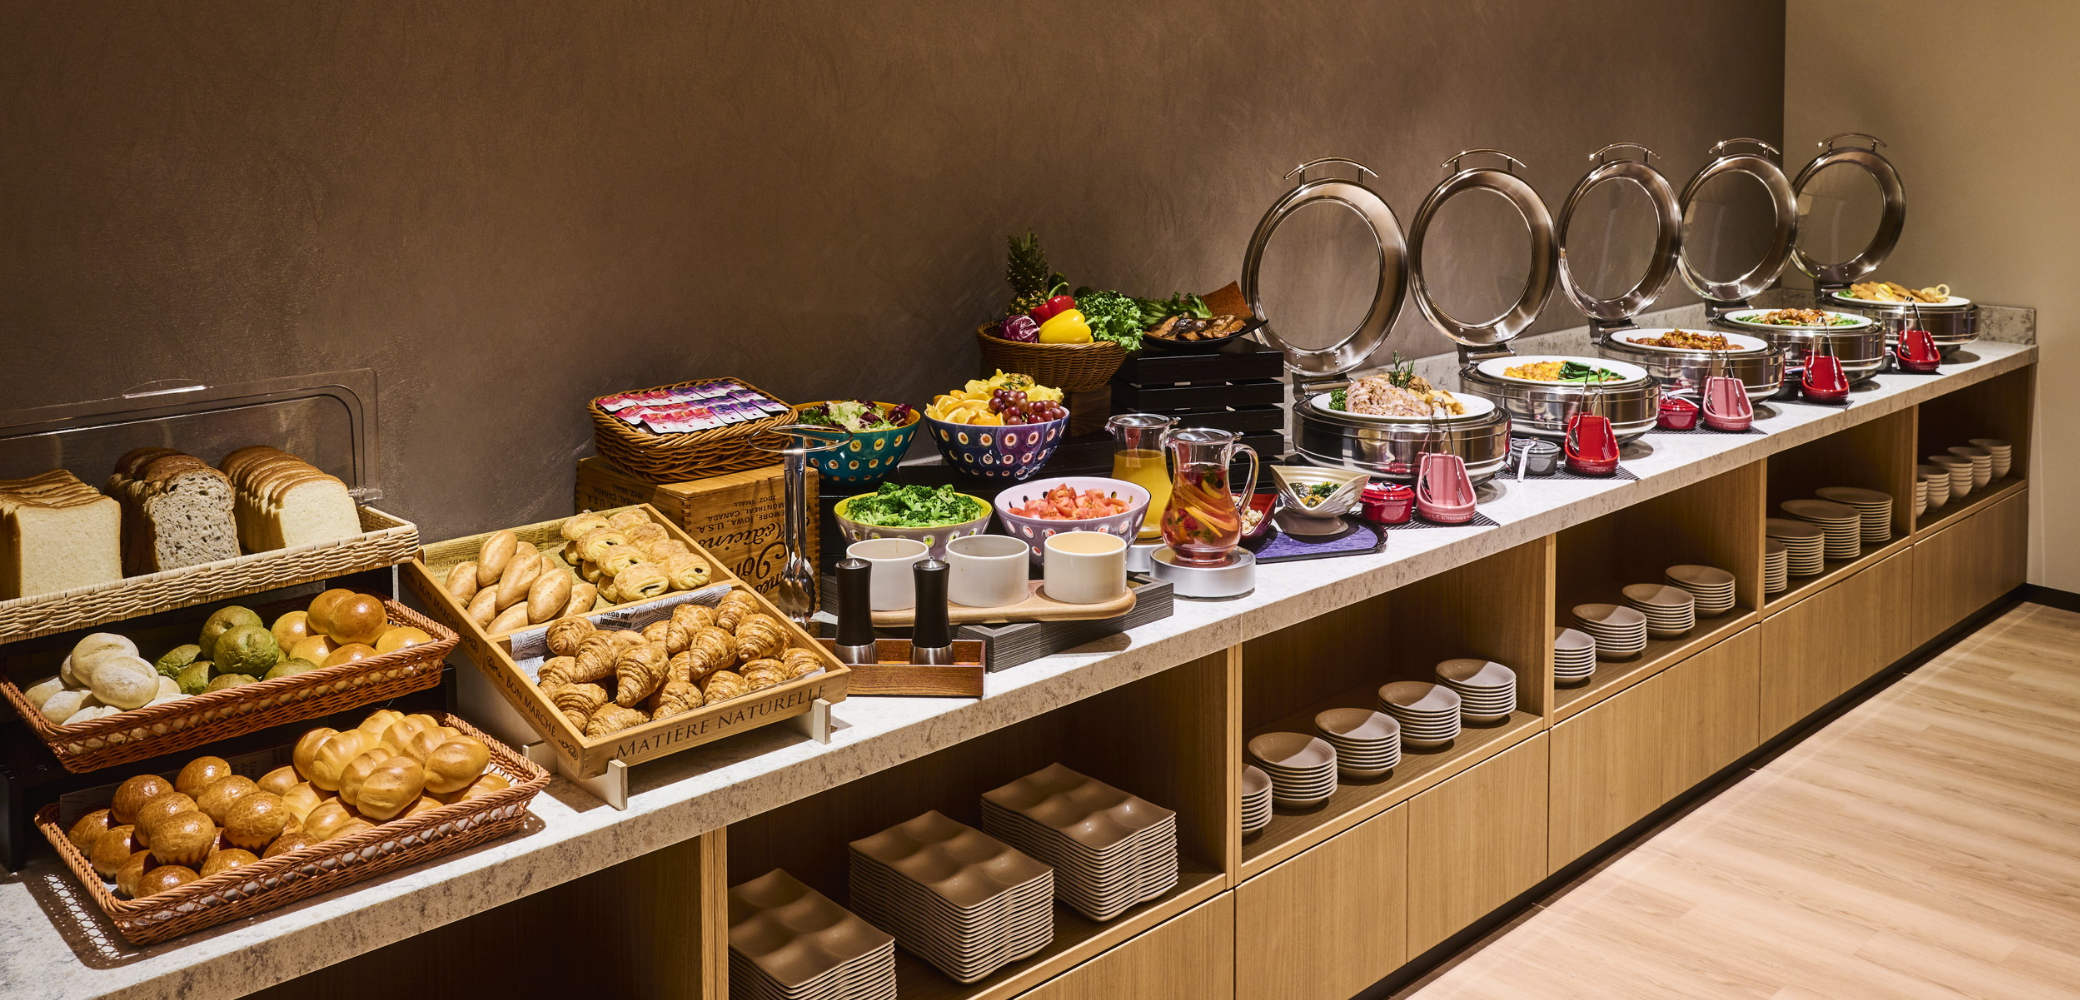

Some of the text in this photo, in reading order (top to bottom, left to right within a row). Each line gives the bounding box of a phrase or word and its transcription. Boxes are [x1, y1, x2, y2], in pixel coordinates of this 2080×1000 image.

[733, 499, 756, 508] SMALL
[696, 522, 724, 534] U.S.A.
[418, 580, 432, 603] BON
[506, 675, 523, 701] BON
[523, 694, 557, 738] MARCHÉ
[615, 684, 827, 760] MATIÈRE NATURELLE
